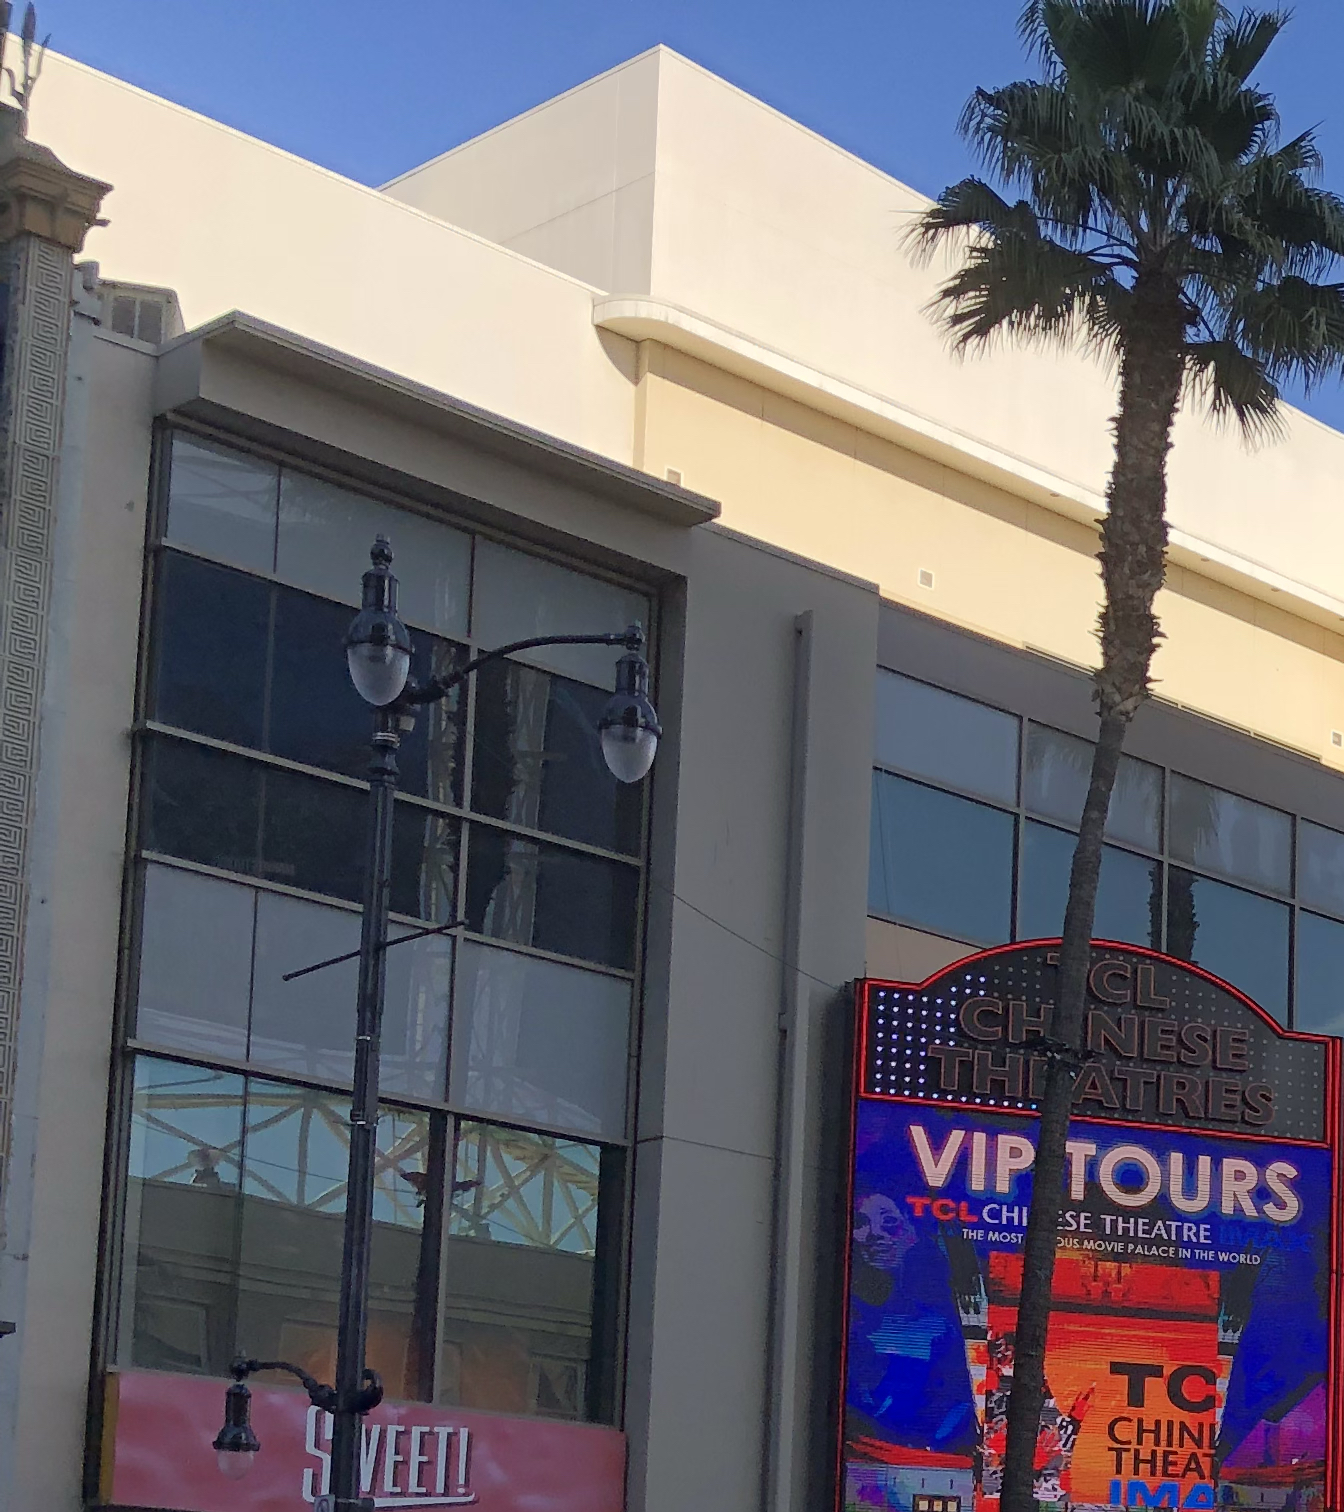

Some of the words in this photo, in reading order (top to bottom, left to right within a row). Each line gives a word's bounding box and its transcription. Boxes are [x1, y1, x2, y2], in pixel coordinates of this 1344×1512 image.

[1047, 952, 1170, 1009] CL
[959, 997, 1249, 1071] CHNESE
[909, 1125, 1035, 1194] VIP
[1065, 1141, 1299, 1222] TOURS
[906, 1197, 979, 1223] TCL
[982, 1203, 1093, 1233] CHISE
[1100, 1214, 1212, 1244] THEATRE
[962, 1229, 985, 1241] THE
[987, 1231, 1024, 1244] MOST
[1083, 1240, 1124, 1253] MOVIE
[1127, 1243, 1175, 1258] PALACE
[1178, 1248, 1191, 1259] IN
[1194, 1249, 1215, 1261] THE
[1218, 1252, 1261, 1265] WORLD
[1109, 1361, 1216, 1413] TC
[1109, 1479, 1215, 1509] IMA
